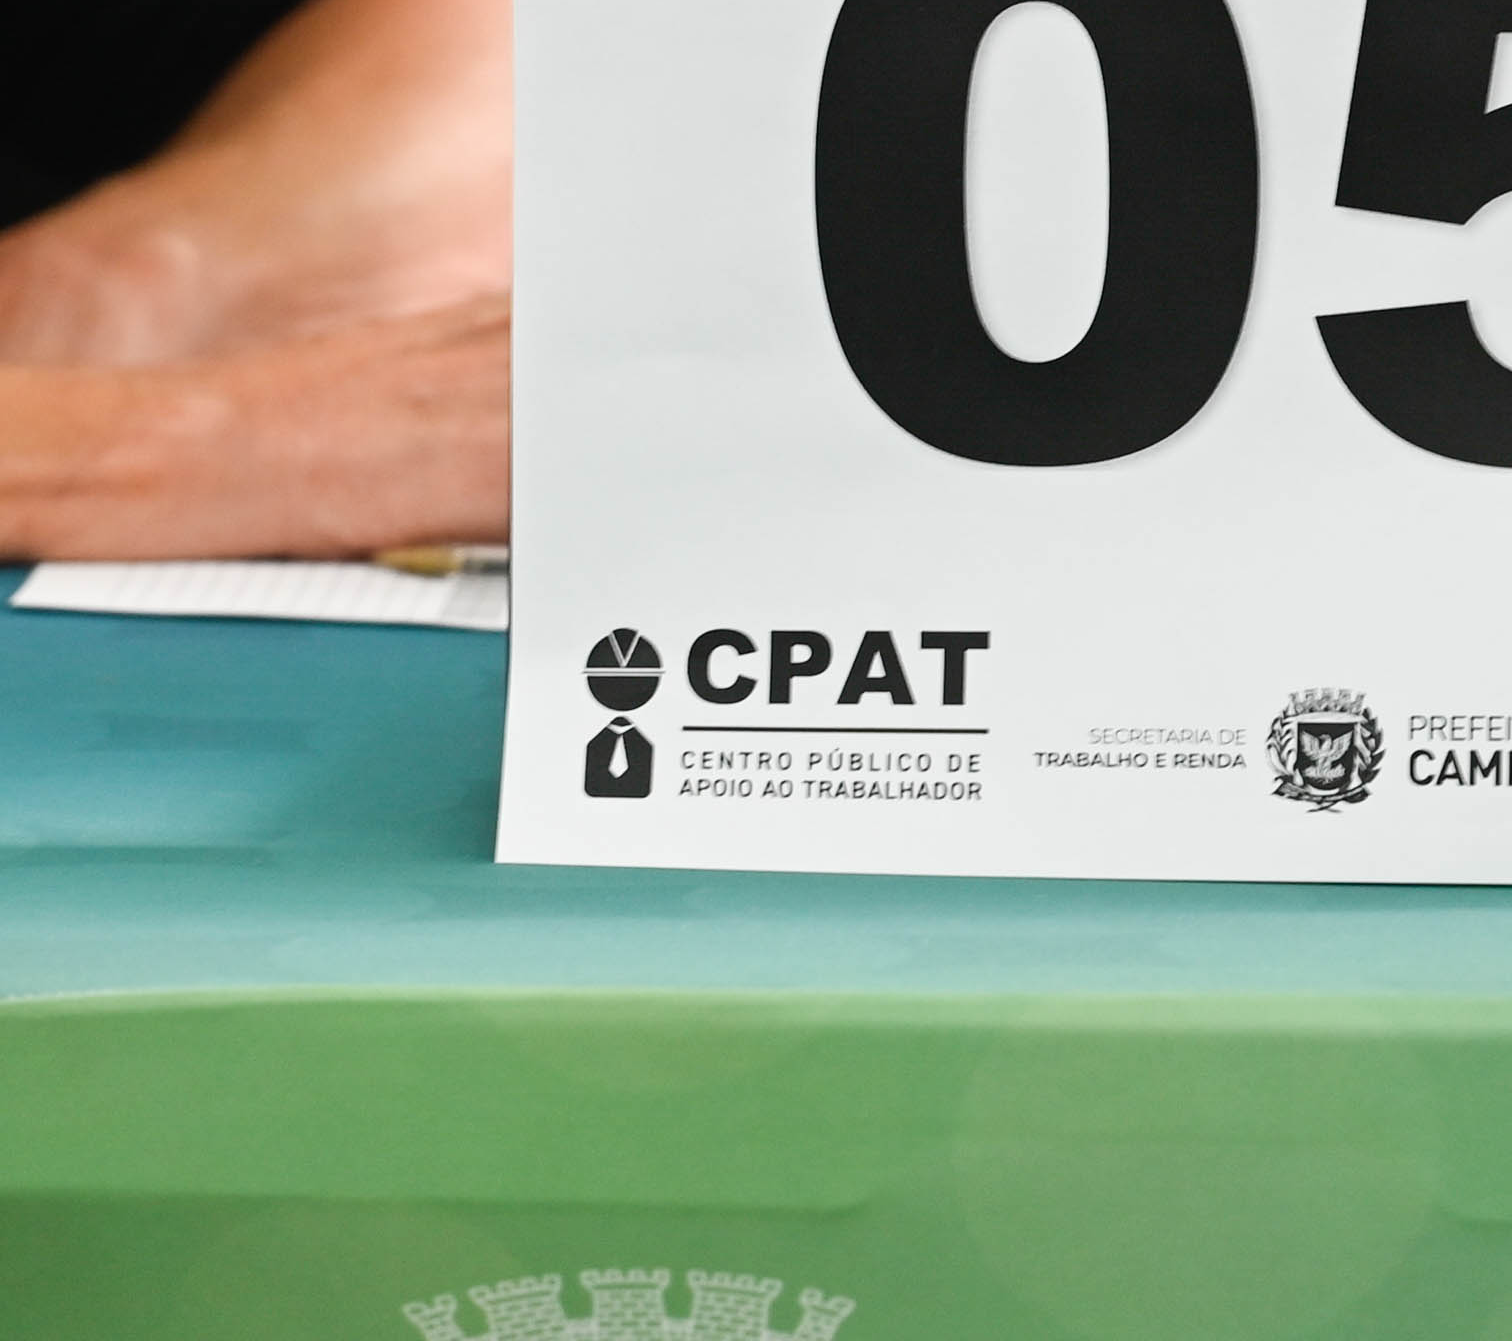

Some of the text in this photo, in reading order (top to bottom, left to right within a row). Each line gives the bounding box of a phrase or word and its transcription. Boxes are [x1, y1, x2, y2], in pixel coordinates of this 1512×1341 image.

[686, 628, 990, 706] CPAT
[1089, 727, 1247, 746] SECRETARIA DE
[681, 748, 981, 774] CENTRO PÚBLICO DE
[1034, 752, 1245, 769] TRABALHO E RENDA
[679, 778, 981, 801] APOIO AO TRABALHADOR
